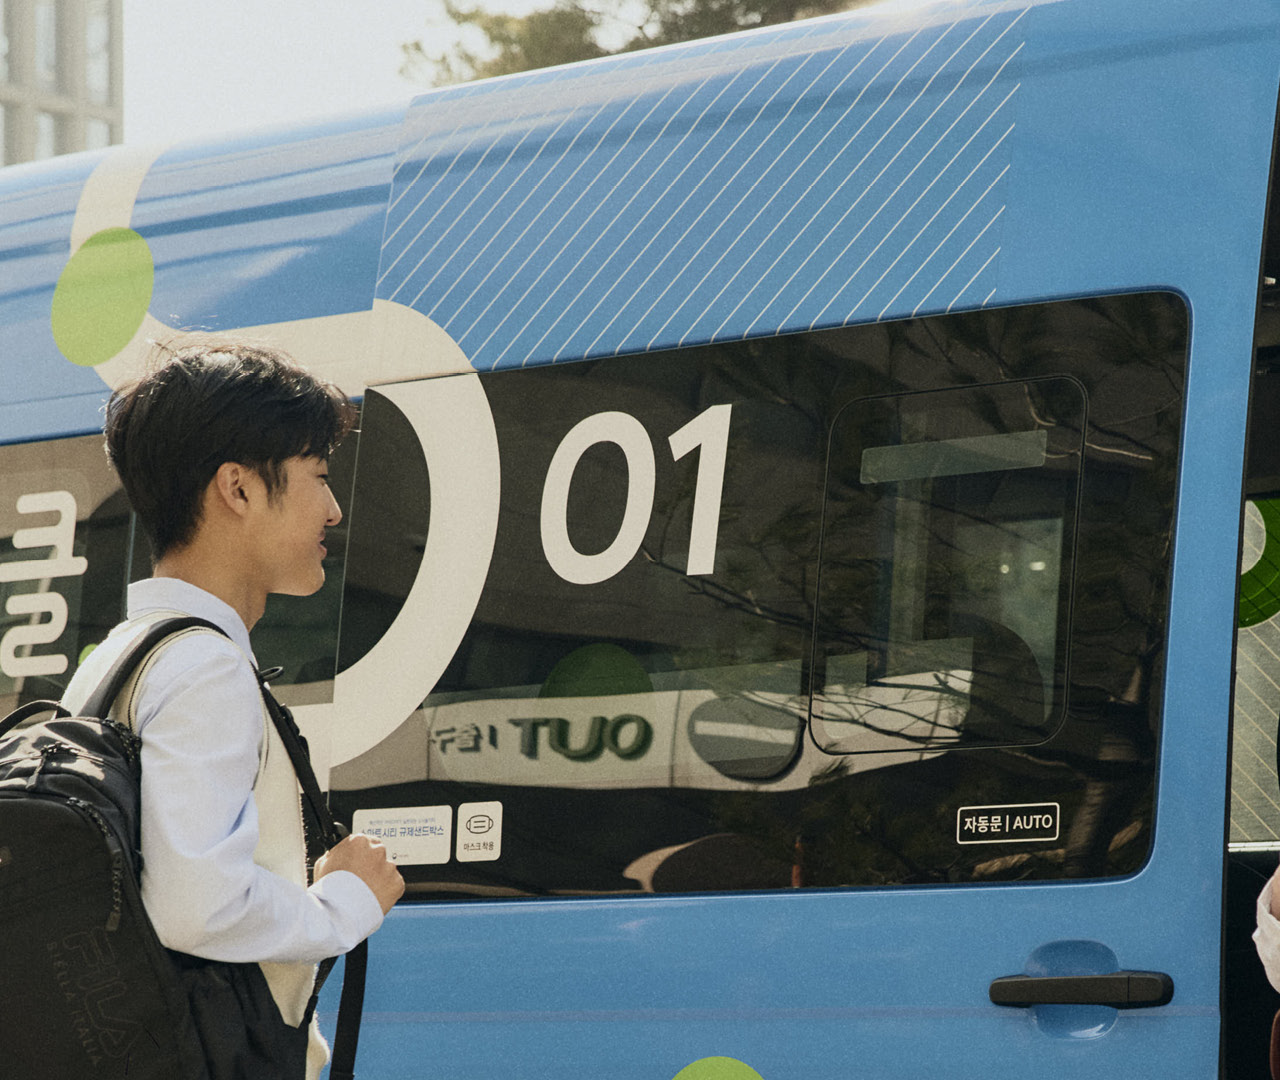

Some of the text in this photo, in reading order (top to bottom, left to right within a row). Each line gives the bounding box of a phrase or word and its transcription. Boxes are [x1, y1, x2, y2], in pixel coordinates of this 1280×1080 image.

[540, 404, 732, 585] 01
[964, 815, 1002, 834] 자동문
[1012, 813, 1053, 830] AUTO
[463, 841, 494, 852] 마스크 착용
